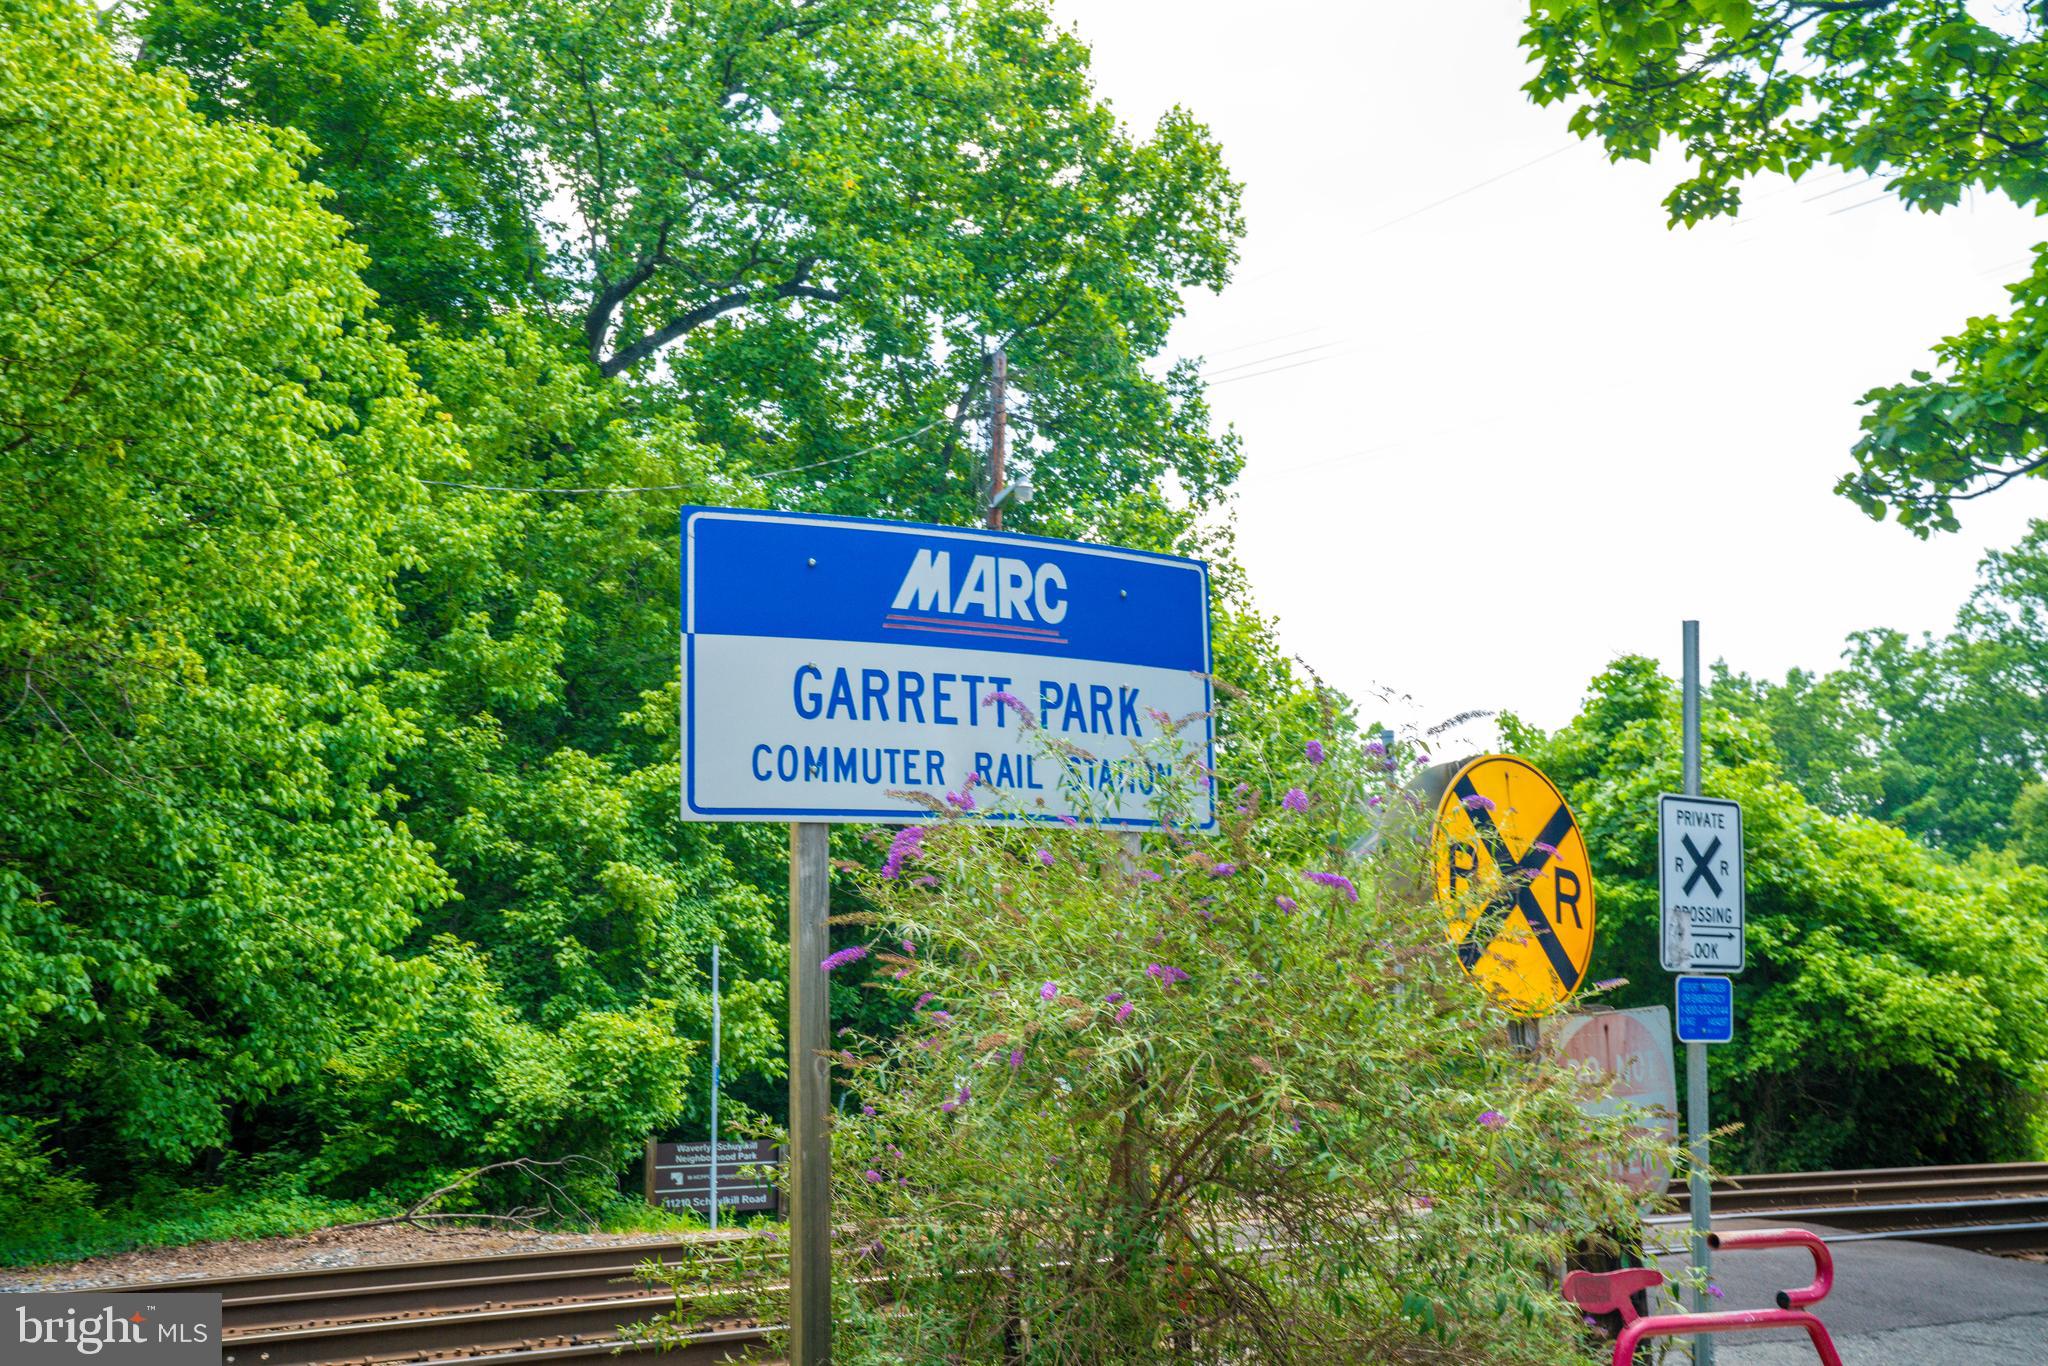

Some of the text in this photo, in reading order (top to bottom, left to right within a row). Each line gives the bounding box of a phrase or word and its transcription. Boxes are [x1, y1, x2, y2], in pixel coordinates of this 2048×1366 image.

[891, 547, 1068, 625] MARC
[793, 663, 1143, 736] GARRETT PARK
[752, 743, 945, 786] COMMUTER
[975, 750, 1043, 790] RAIL
[1677, 809, 1725, 829] PRIVATE
[1675, 857, 1684, 873] R
[1720, 860, 1729, 876] R
[1555, 866, 1583, 929] R
[1690, 942, 1719, 960] OOK
[676, 1143, 711, 1153] Waverly
[675, 1152, 757, 1164] Neighbohood Park
[666, 1194, 767, 1208] 11210 Schylkill Road
